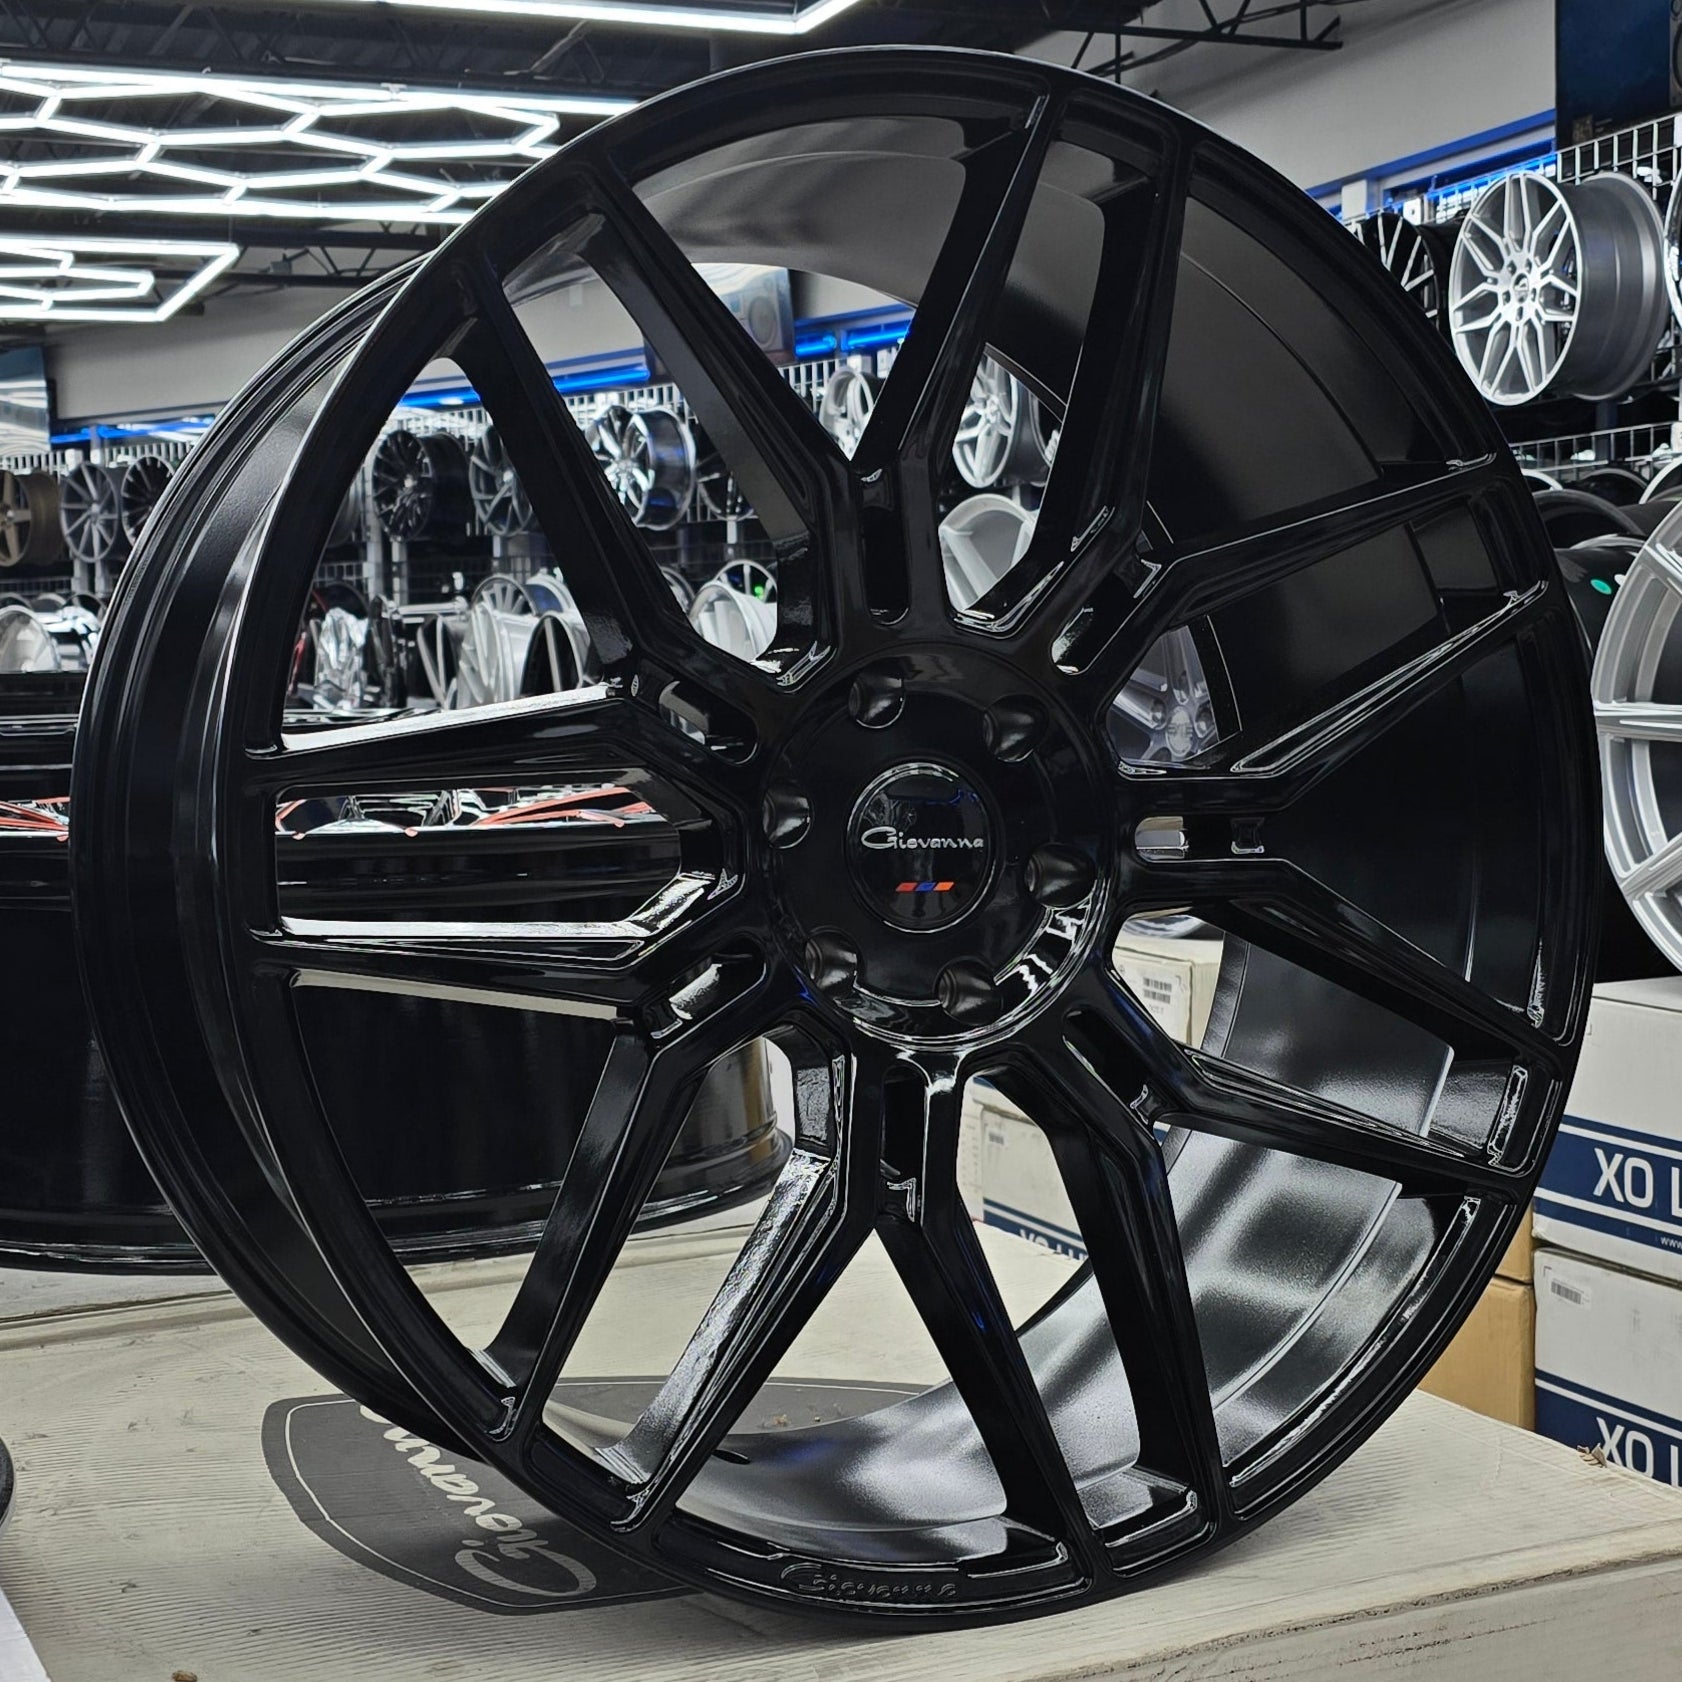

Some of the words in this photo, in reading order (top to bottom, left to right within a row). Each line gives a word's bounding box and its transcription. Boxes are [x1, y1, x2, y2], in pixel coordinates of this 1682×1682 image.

[861, 826, 984, 849] Giovanna
[1593, 1147, 1654, 1208] XO
[1596, 1416, 1654, 1479] XO
